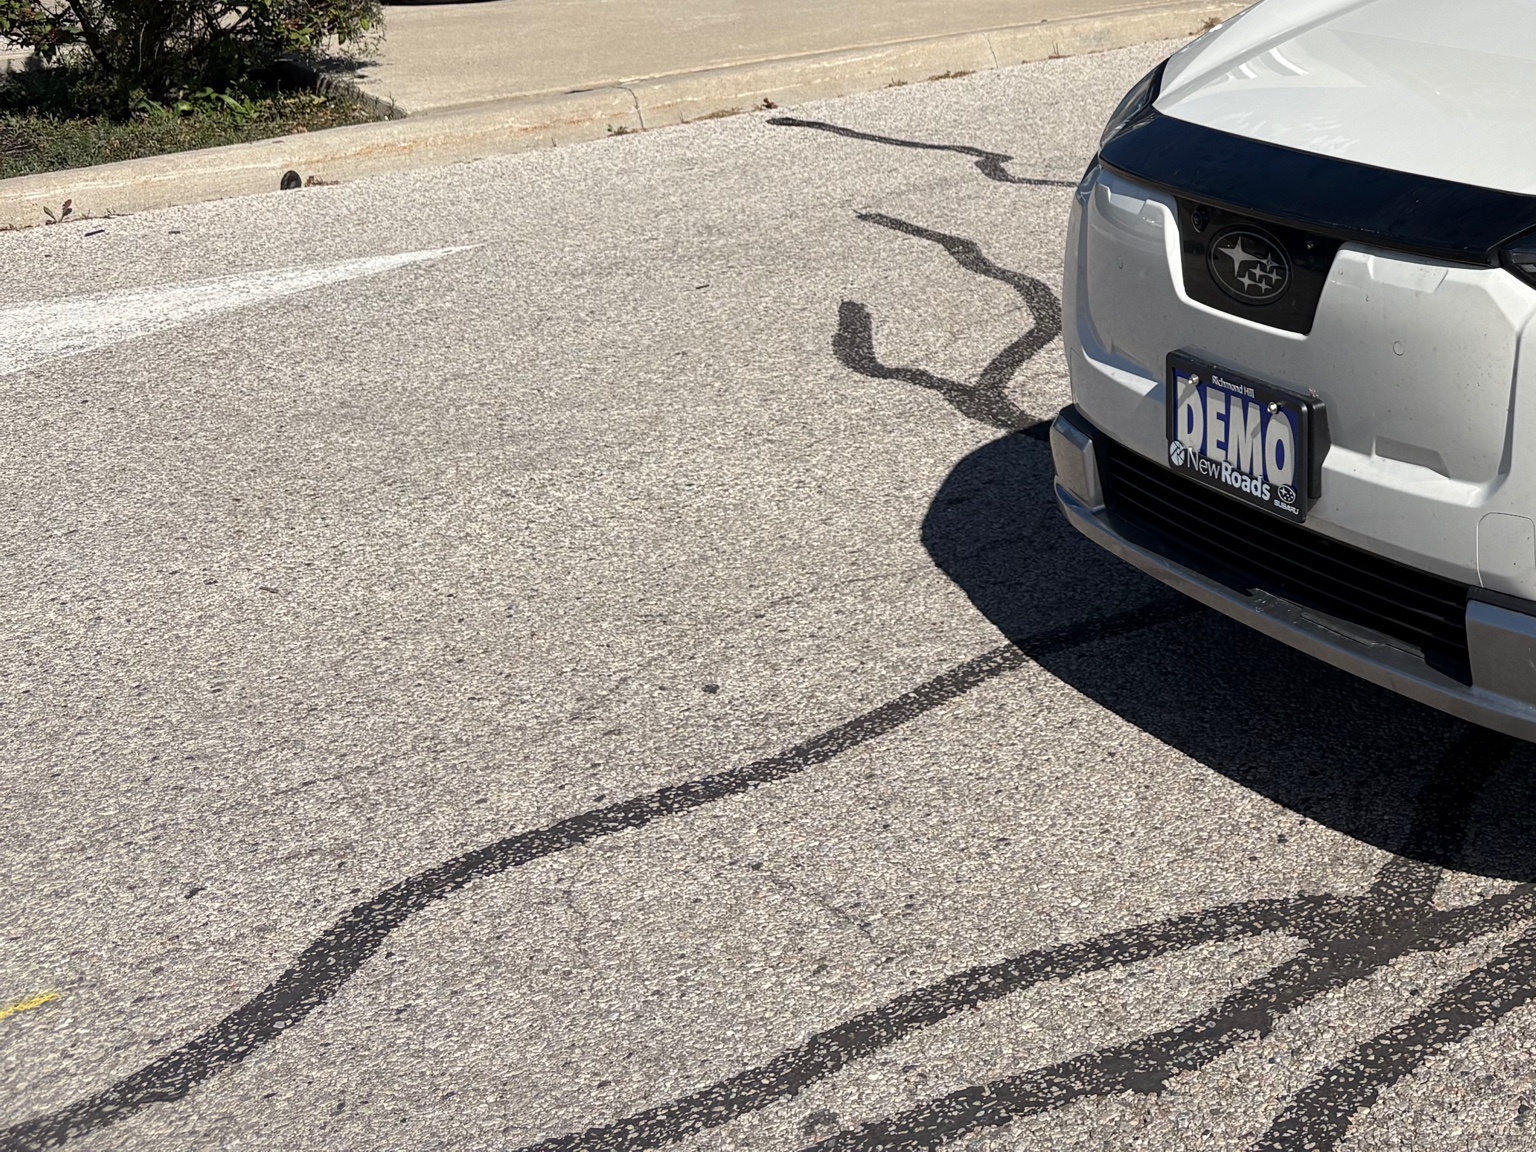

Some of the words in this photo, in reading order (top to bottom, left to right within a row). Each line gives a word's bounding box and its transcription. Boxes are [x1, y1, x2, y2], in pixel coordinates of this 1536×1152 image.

[1211, 375, 1244, 395] Richmond
[1243, 385, 1255, 399] Hill
[1176, 378, 1295, 488] DEMO
[1273, 499, 1300, 515] SUBARU
